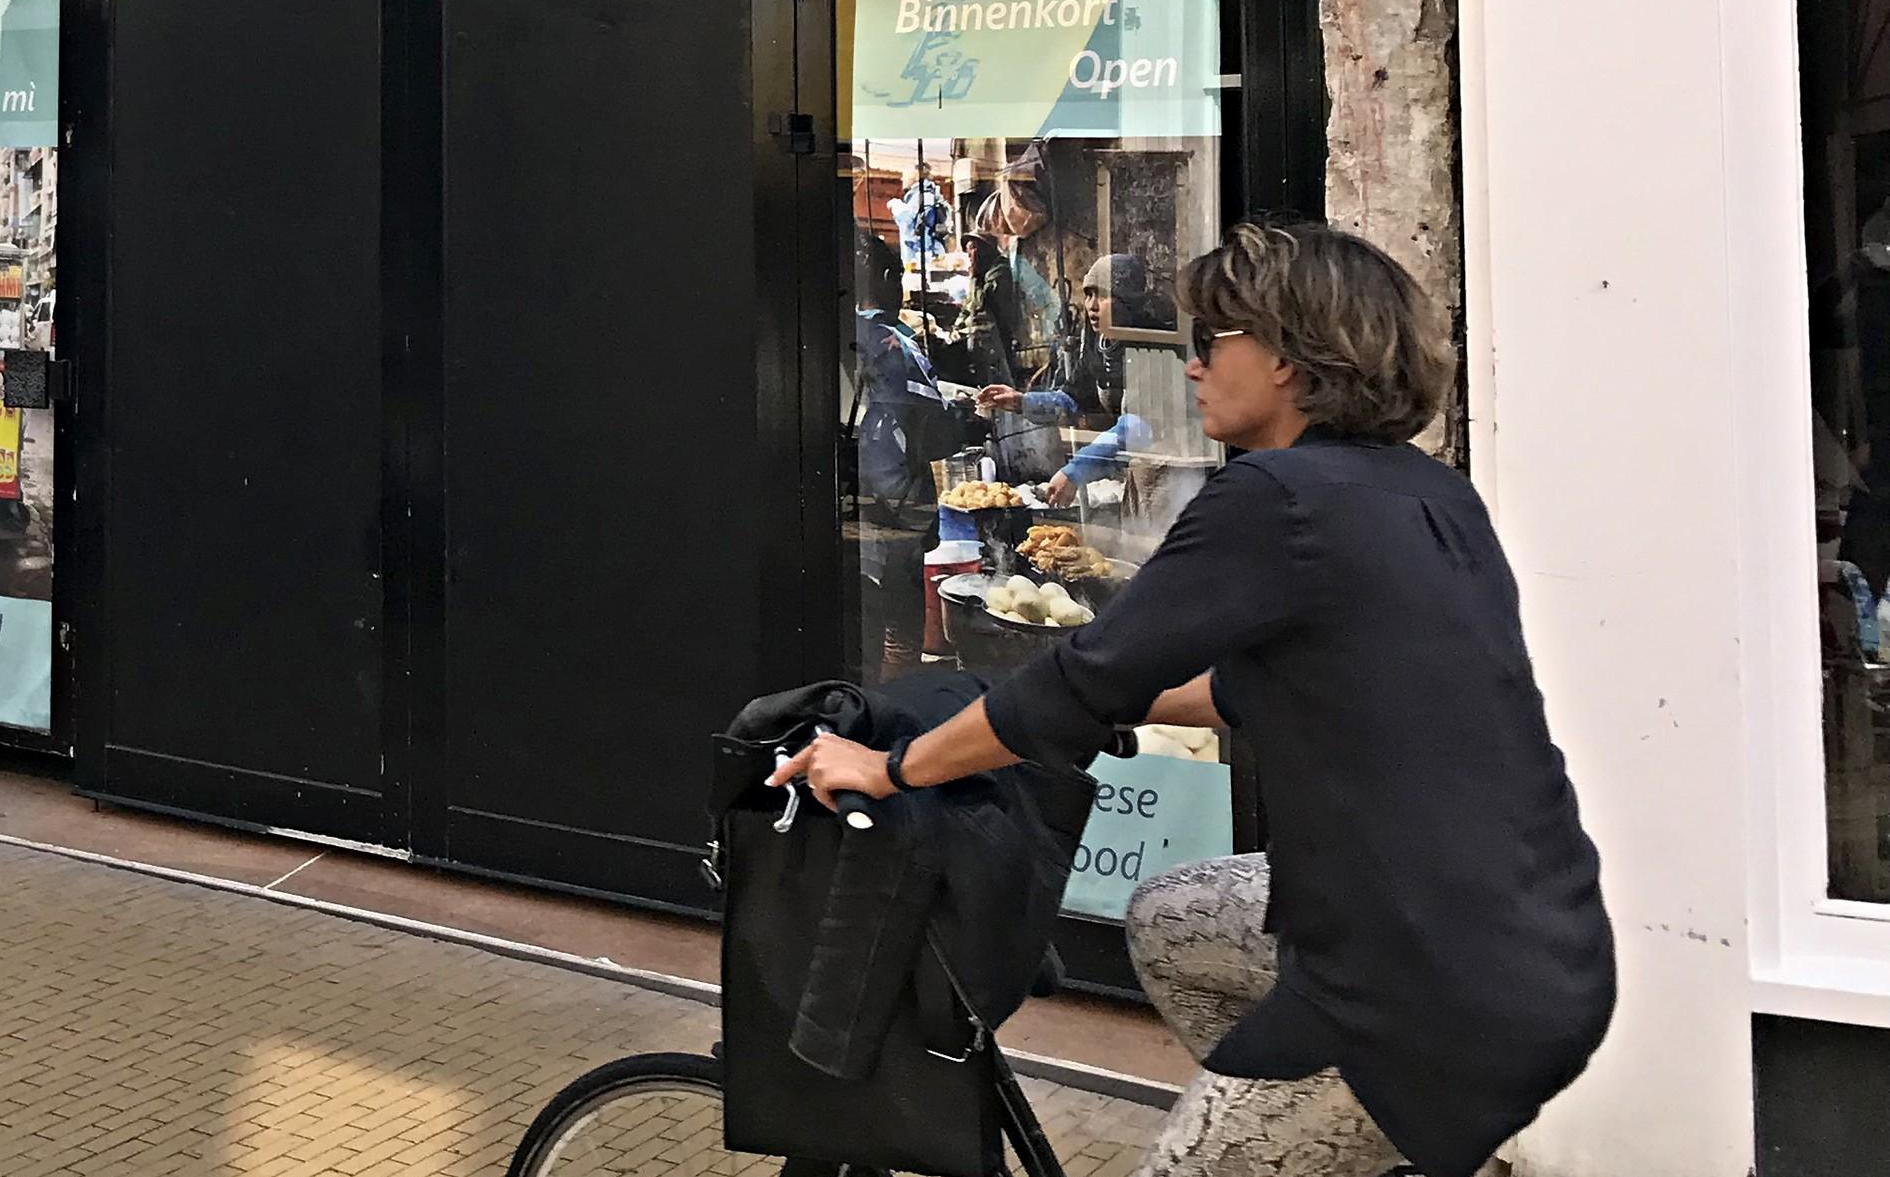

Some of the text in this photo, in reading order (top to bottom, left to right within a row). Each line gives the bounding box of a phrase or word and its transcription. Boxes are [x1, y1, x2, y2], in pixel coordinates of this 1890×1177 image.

[1068, 49, 1178, 100] Open
[2, 81, 36, 113] mì
[1095, 783, 1159, 819] ese
[1071, 840, 1145, 882] ood
